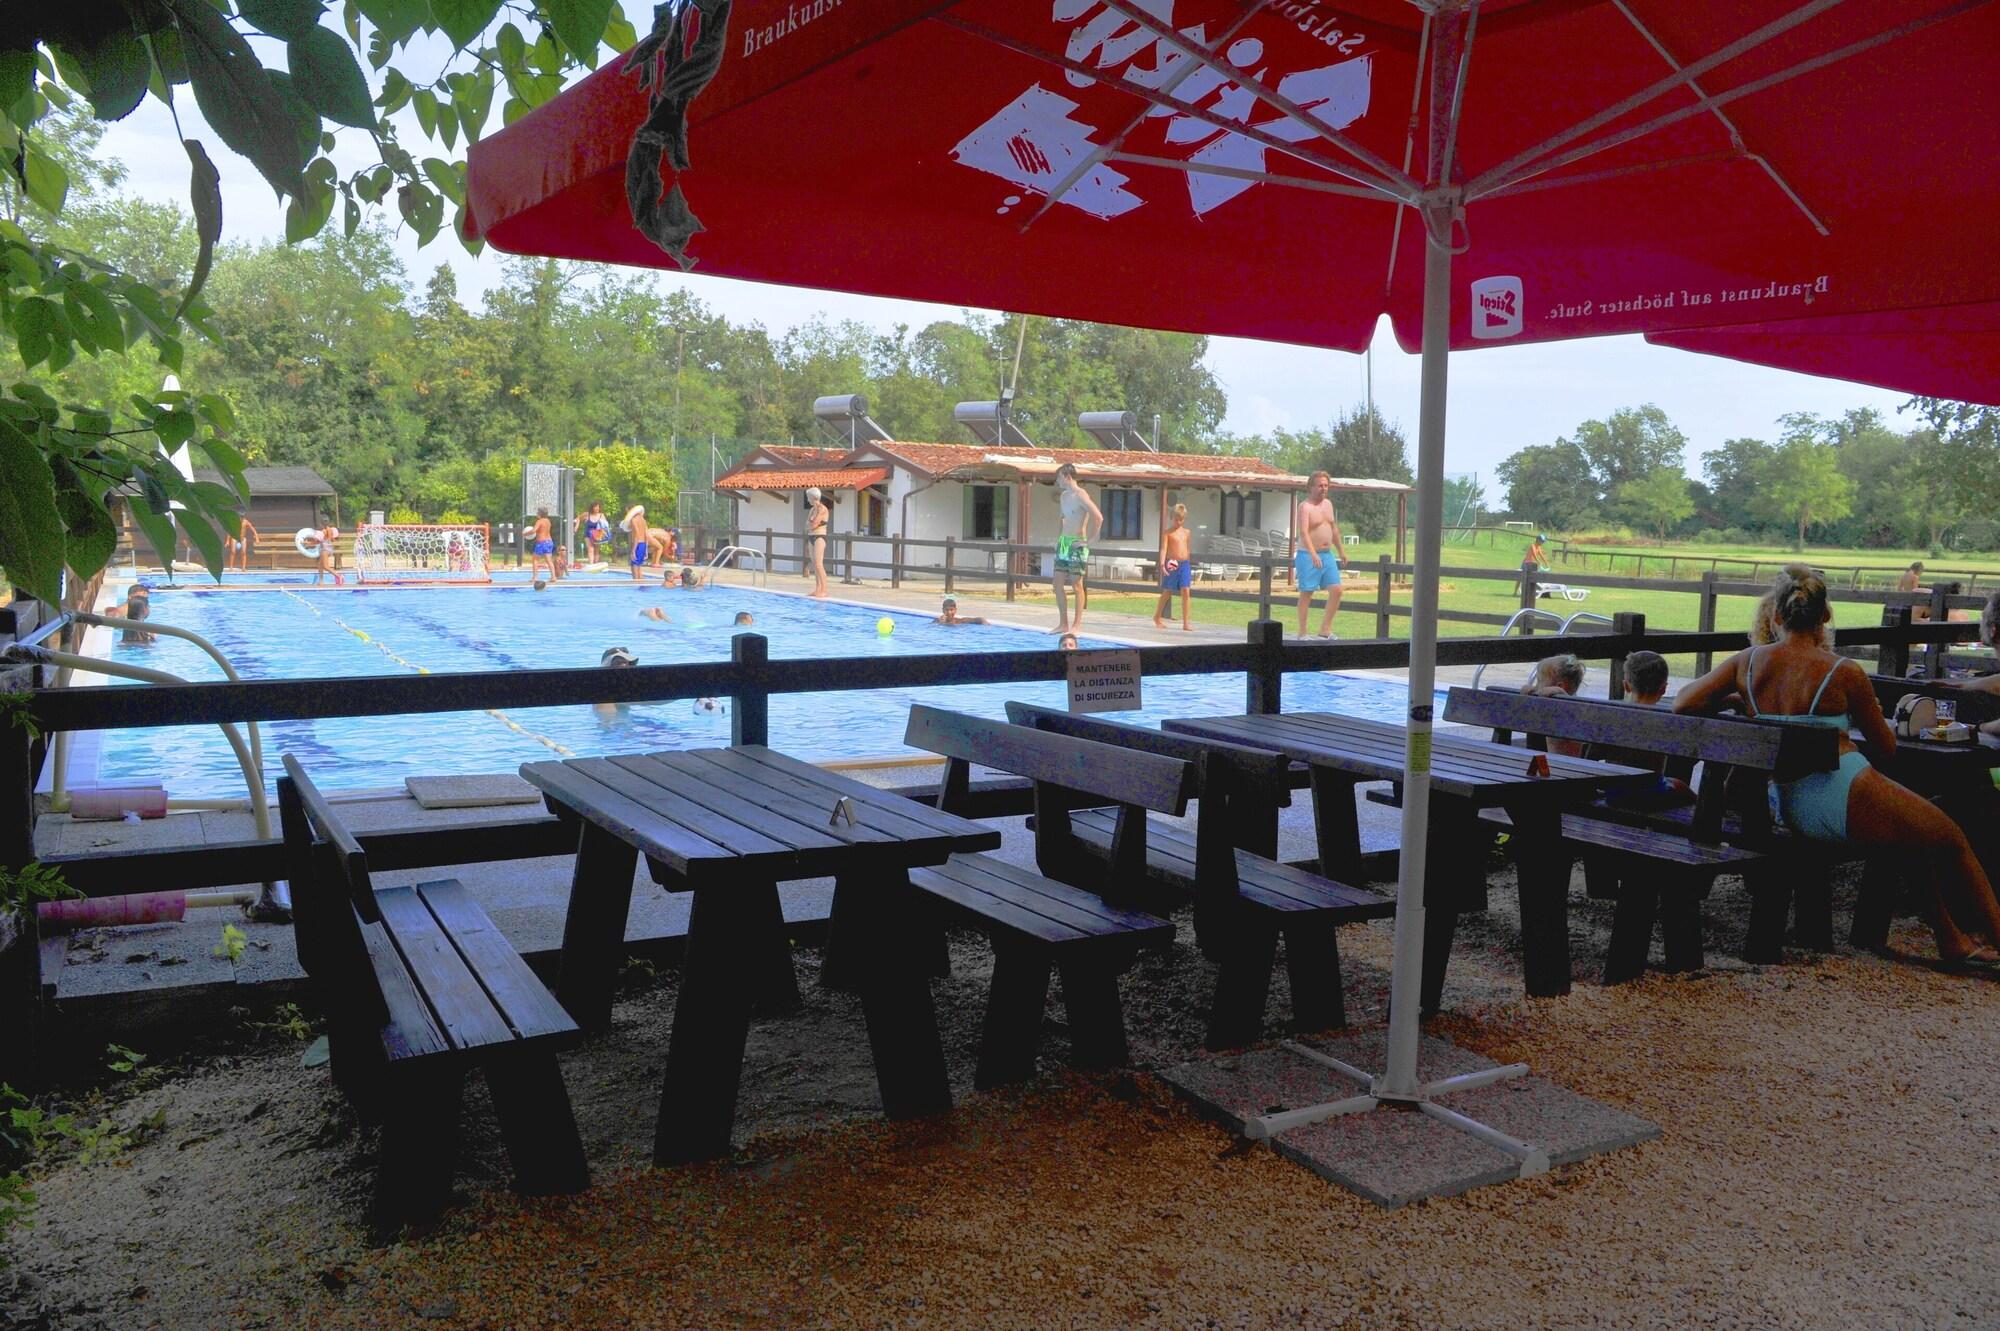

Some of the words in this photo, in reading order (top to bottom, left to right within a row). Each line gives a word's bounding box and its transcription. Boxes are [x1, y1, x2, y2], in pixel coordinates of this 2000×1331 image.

[1076, 663, 1132, 673] MANTENERE
[1074, 680, 1086, 688] LA
[1088, 677, 1135, 687] DISTANZA
[1074, 694, 1085, 702] DI
[1086, 691, 1135, 701] SICUREZZA
